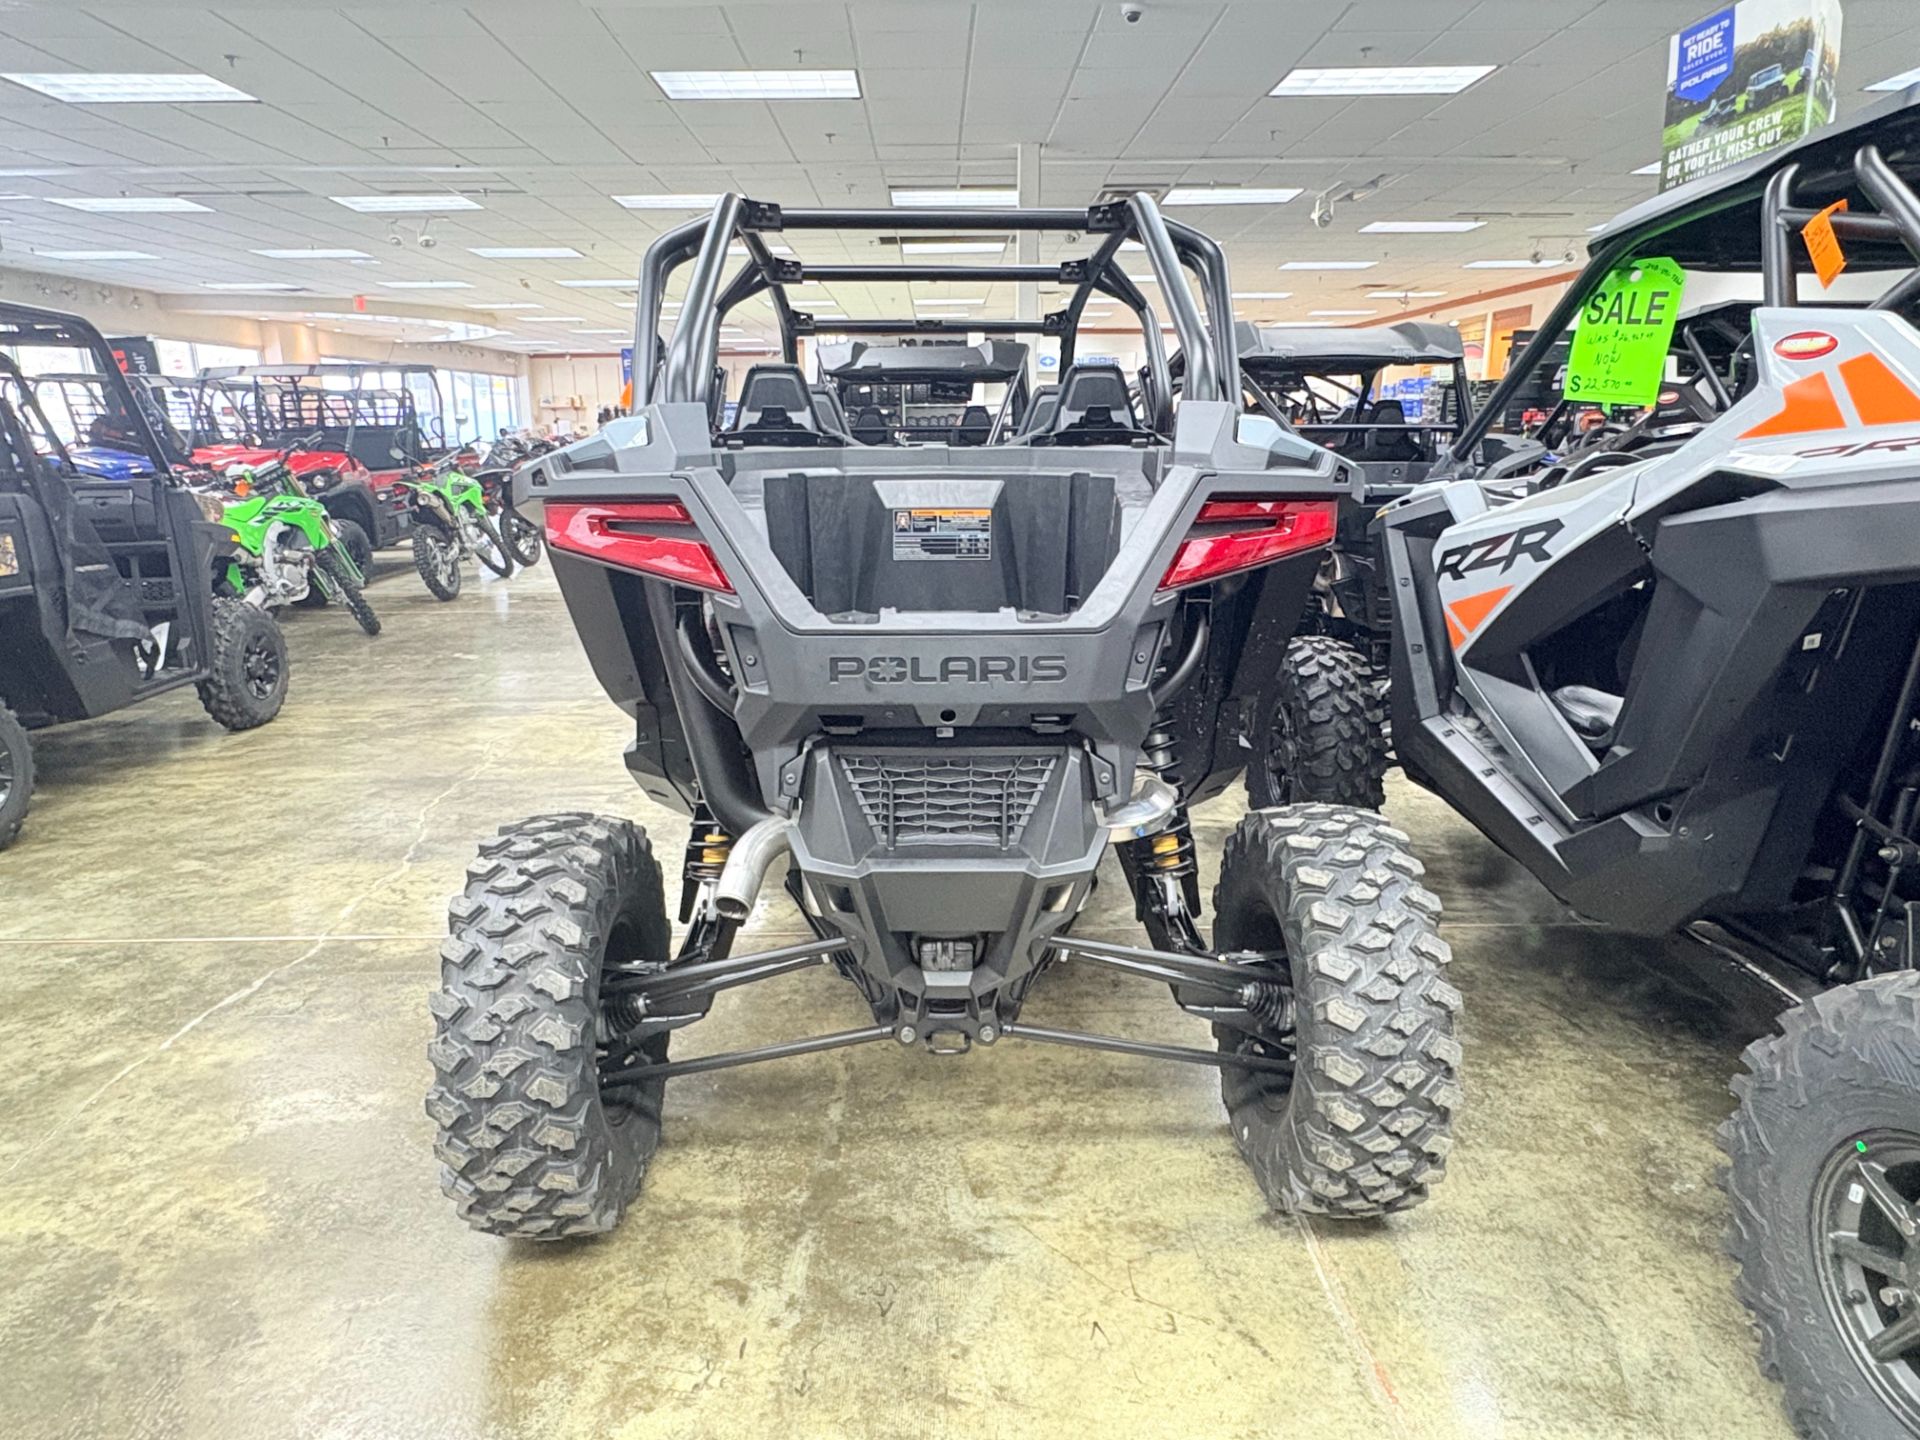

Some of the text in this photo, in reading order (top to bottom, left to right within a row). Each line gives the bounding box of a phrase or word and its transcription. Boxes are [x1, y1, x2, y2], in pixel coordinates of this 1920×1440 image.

[1683, 18, 1731, 48] GET READY TO
[1686, 31, 1724, 64] RIDE
[1704, 47, 1728, 62] EVENT
[1680, 62, 1728, 91] POLARIS
[1668, 136, 1711, 164] GATHER
[1714, 124, 1745, 147] YOUR
[1747, 108, 1784, 134] CREW
[1666, 162, 1681, 180] OR
[1683, 149, 1723, 174] YOU'LL
[1726, 139, 1757, 160] MISS
[1758, 125, 1784, 147] OUT
[1586, 291, 1670, 326] SALE
[1586, 332, 1609, 345] WAS
[1594, 352, 1622, 366] NOW
[1436, 518, 1566, 582] RZR
[828, 655, 1068, 684] POLARIS
